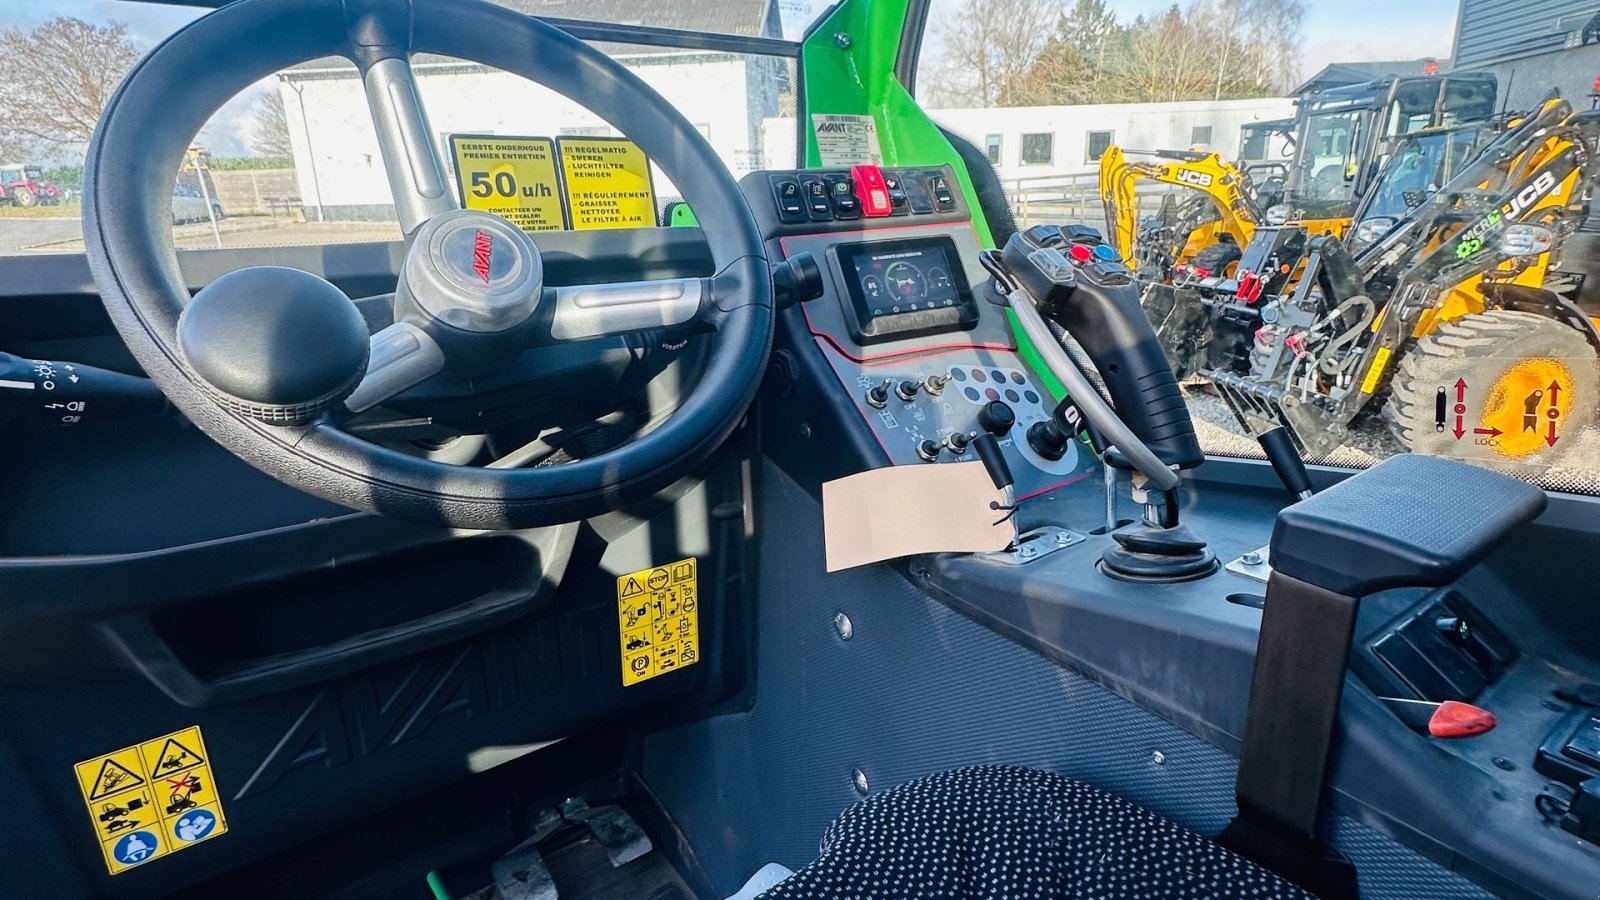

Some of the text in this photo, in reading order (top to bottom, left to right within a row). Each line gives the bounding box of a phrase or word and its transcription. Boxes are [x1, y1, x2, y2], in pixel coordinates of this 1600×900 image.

[817, 123, 846, 133] AVANT
[495, 144, 545, 152] ONDERHOUD
[575, 146, 627, 154] REGELMATIG
[463, 152, 500, 160] PREMIER
[471, 171, 552, 198] 50 u/h
[1176, 168, 1213, 187] JCB
[1504, 171, 1556, 221] JCB
[473, 229, 493, 284] AVANT
[648, 573, 668, 583] STOP
[233, 602, 612, 801] AVANT
